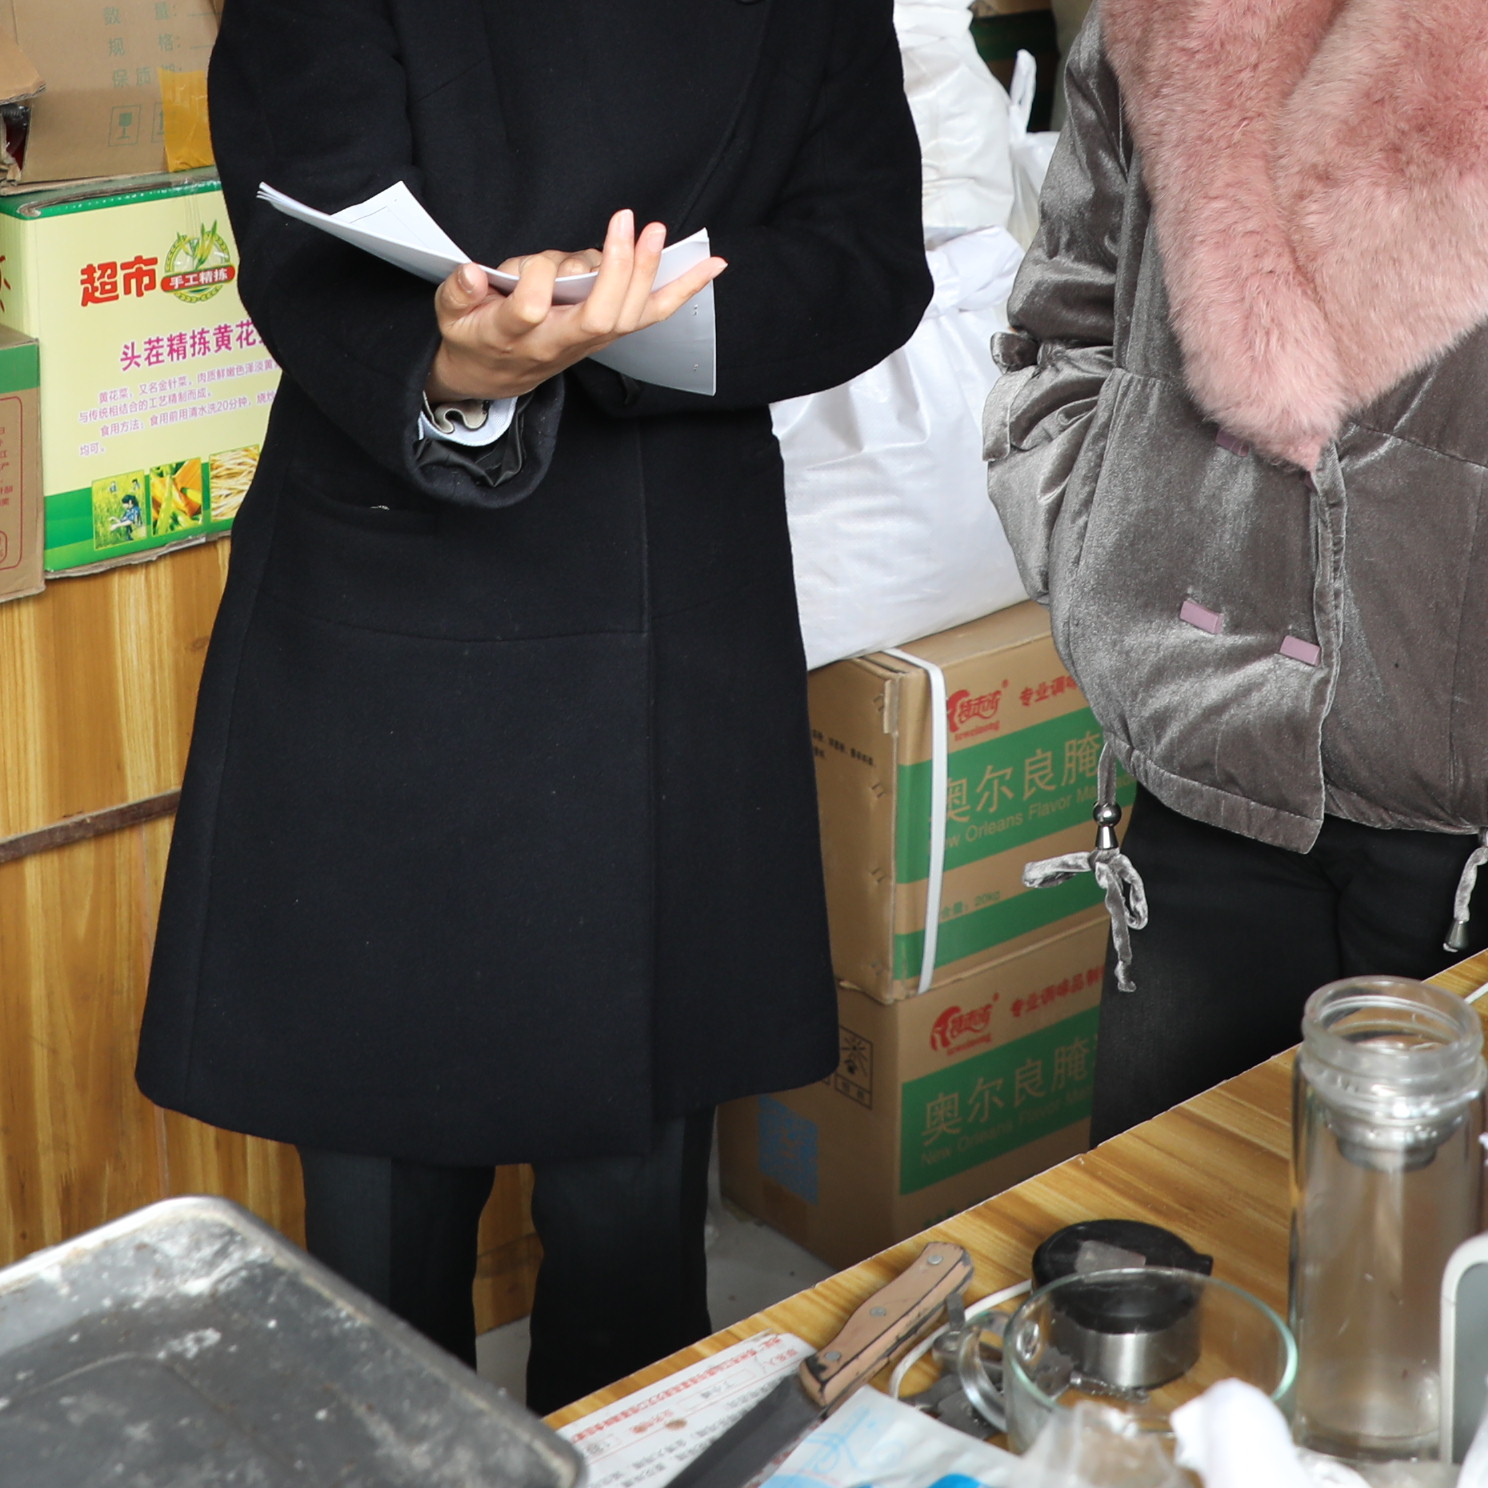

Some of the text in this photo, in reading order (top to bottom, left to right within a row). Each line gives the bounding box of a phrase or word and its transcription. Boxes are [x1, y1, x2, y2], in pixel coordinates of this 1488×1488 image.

[80, 255, 159, 307] 超市
[168, 269, 229, 290] 手工精拣
[119, 318, 268, 372] 头茬精拣黄花
[965, 794, 1072, 844] Orleans Flavor
